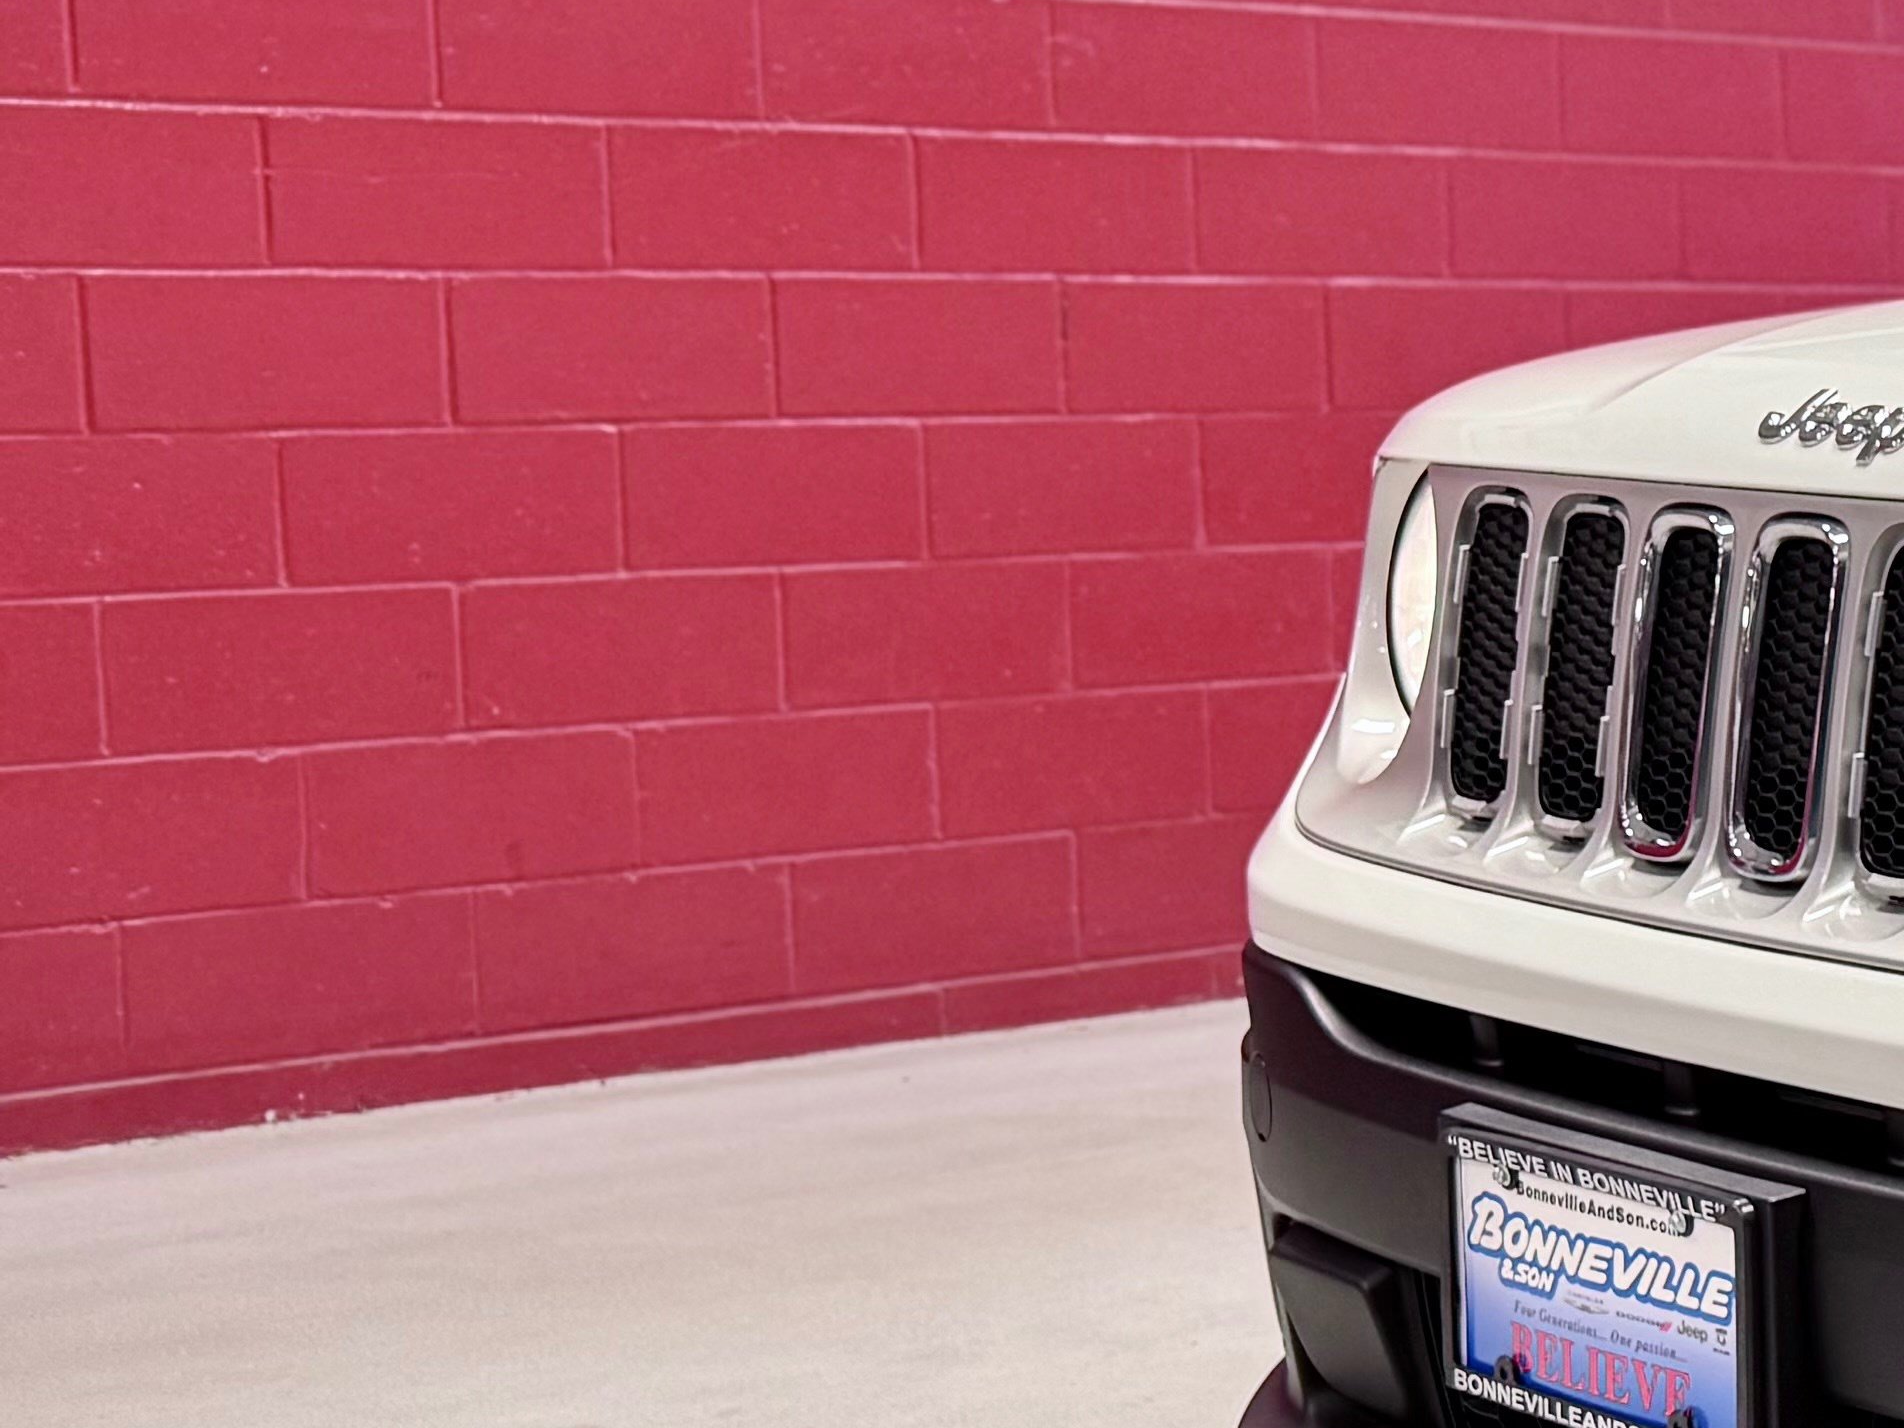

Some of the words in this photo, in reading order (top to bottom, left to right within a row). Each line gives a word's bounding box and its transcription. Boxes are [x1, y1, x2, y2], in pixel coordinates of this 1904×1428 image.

[1549, 1160, 1574, 1185] IN
[1469, 1195, 1735, 1320] BONNEVILLE
[1676, 1319, 1709, 1345] Jeep
[1509, 1319, 1692, 1418] BELIEVE
